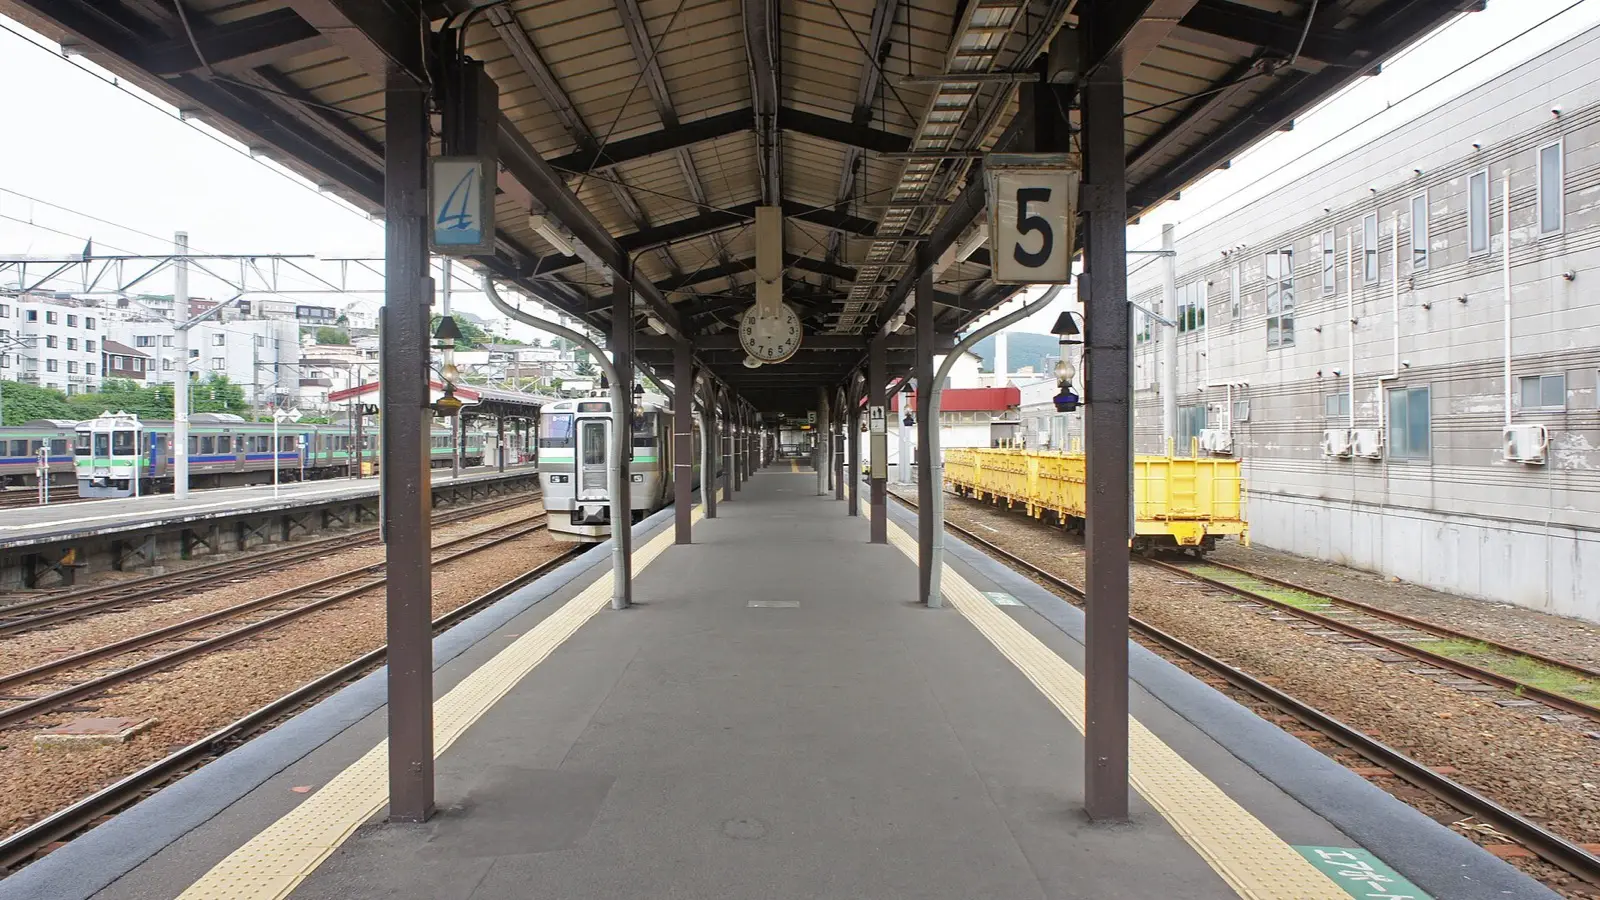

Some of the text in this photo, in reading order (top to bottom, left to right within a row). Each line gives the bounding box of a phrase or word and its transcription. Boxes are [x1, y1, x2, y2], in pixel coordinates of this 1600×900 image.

[437, 168, 475, 230] 4
[1013, 188, 1053, 268] 5
[748, 316, 756, 325] 10
[787, 316, 793, 324] 2
[746, 327, 752, 335] 9
[789, 327, 795, 335] 3
[749, 338, 755, 346] 8
[758, 345, 764, 353] 7
[767, 348, 773, 356] 6
[777, 345, 783, 353] 5
[809, 413, 815, 422] 5
